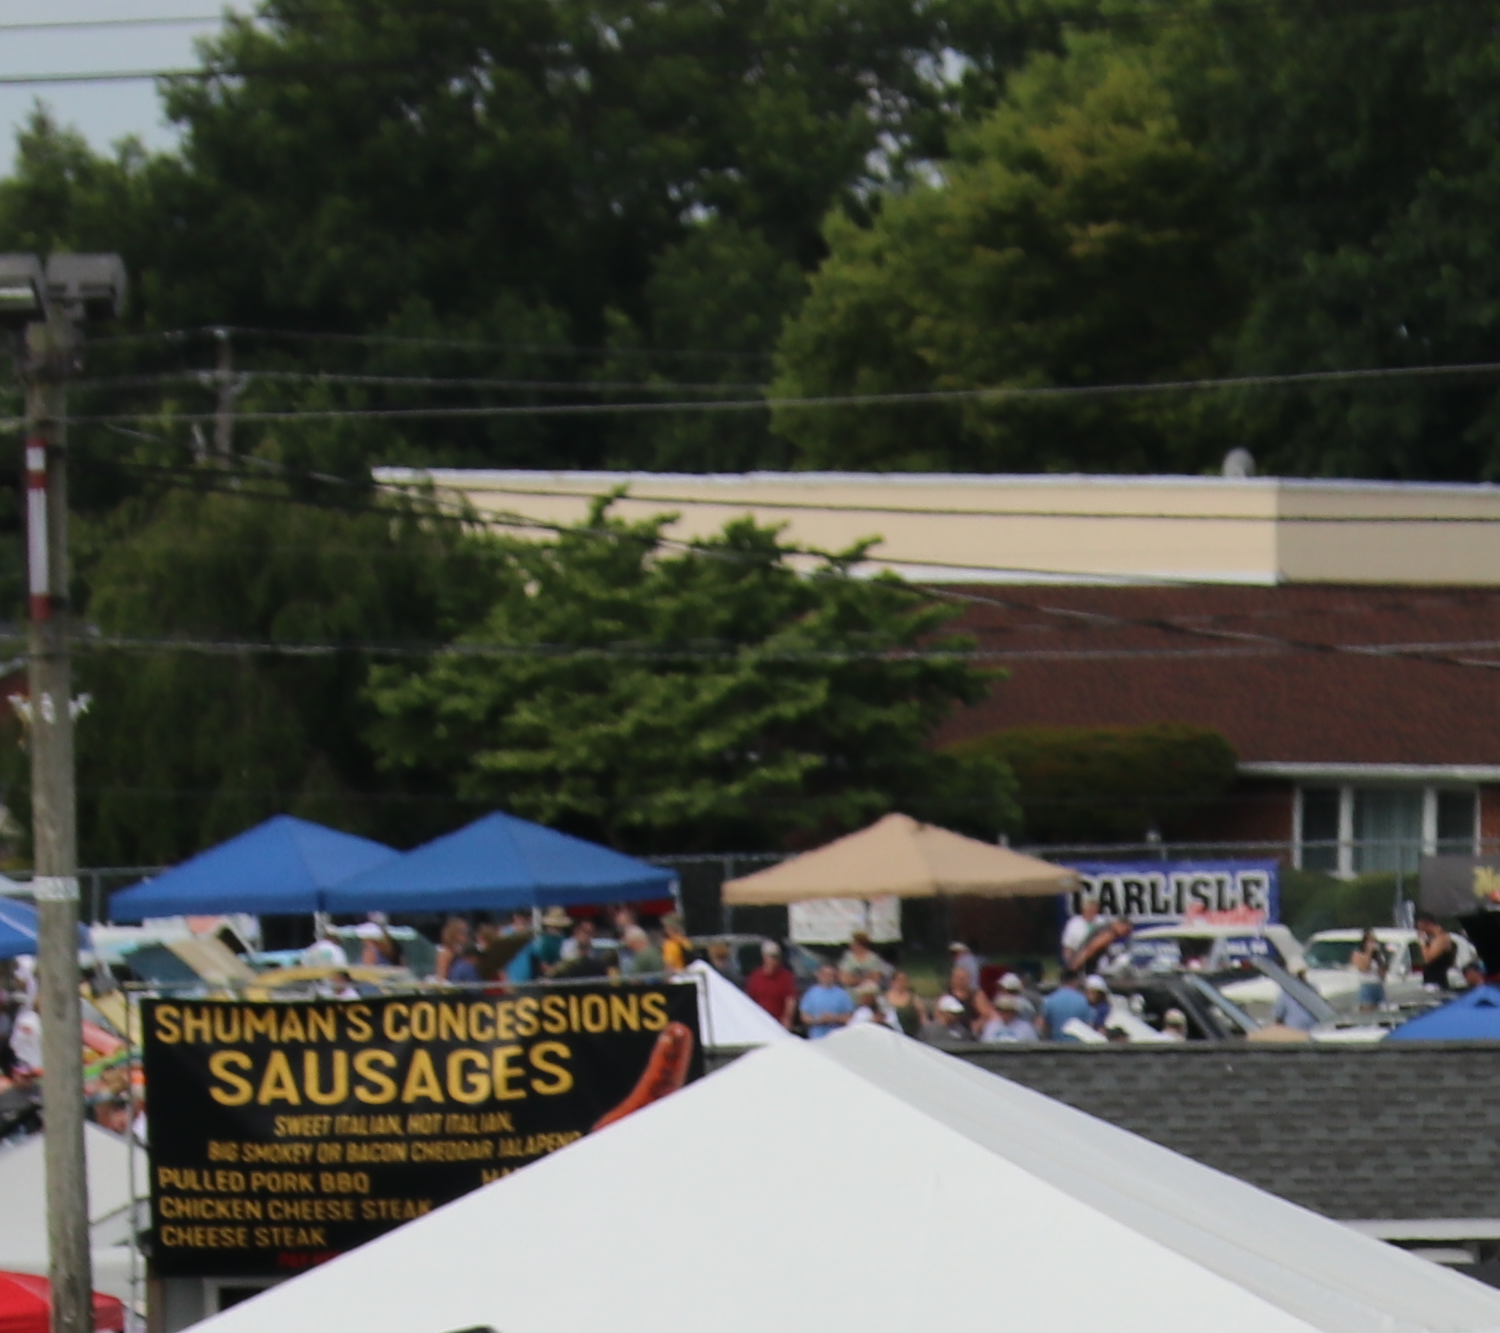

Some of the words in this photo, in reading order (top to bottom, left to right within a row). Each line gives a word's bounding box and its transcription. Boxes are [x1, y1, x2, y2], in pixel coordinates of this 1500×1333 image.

[1071, 876, 1265, 915] CARLISLE
[154, 1002, 373, 1046] SHUMAN'S
[382, 992, 670, 1042] CONCESSIONS
[207, 1041, 575, 1107] SAUSAGES
[273, 1114, 332, 1138] SWEET
[407, 1112, 443, 1136] HOT
[207, 1139, 239, 1163] BIG
[242, 1141, 315, 1164] SMOKEY
[316, 1141, 343, 1164] OR
[346, 1141, 409, 1164] BACON
[410, 1139, 495, 1163] CHEDDAR
[158, 1166, 246, 1194] PULLED
[250, 1170, 316, 1194] PORK
[320, 1170, 372, 1195] BBQ
[159, 1196, 263, 1220] CHICKEN
[268, 1198, 355, 1222] CHEESE
[361, 1198, 433, 1222] STEAK
[160, 1225, 249, 1248] CHEESE
[254, 1226, 328, 1248] STEAK
